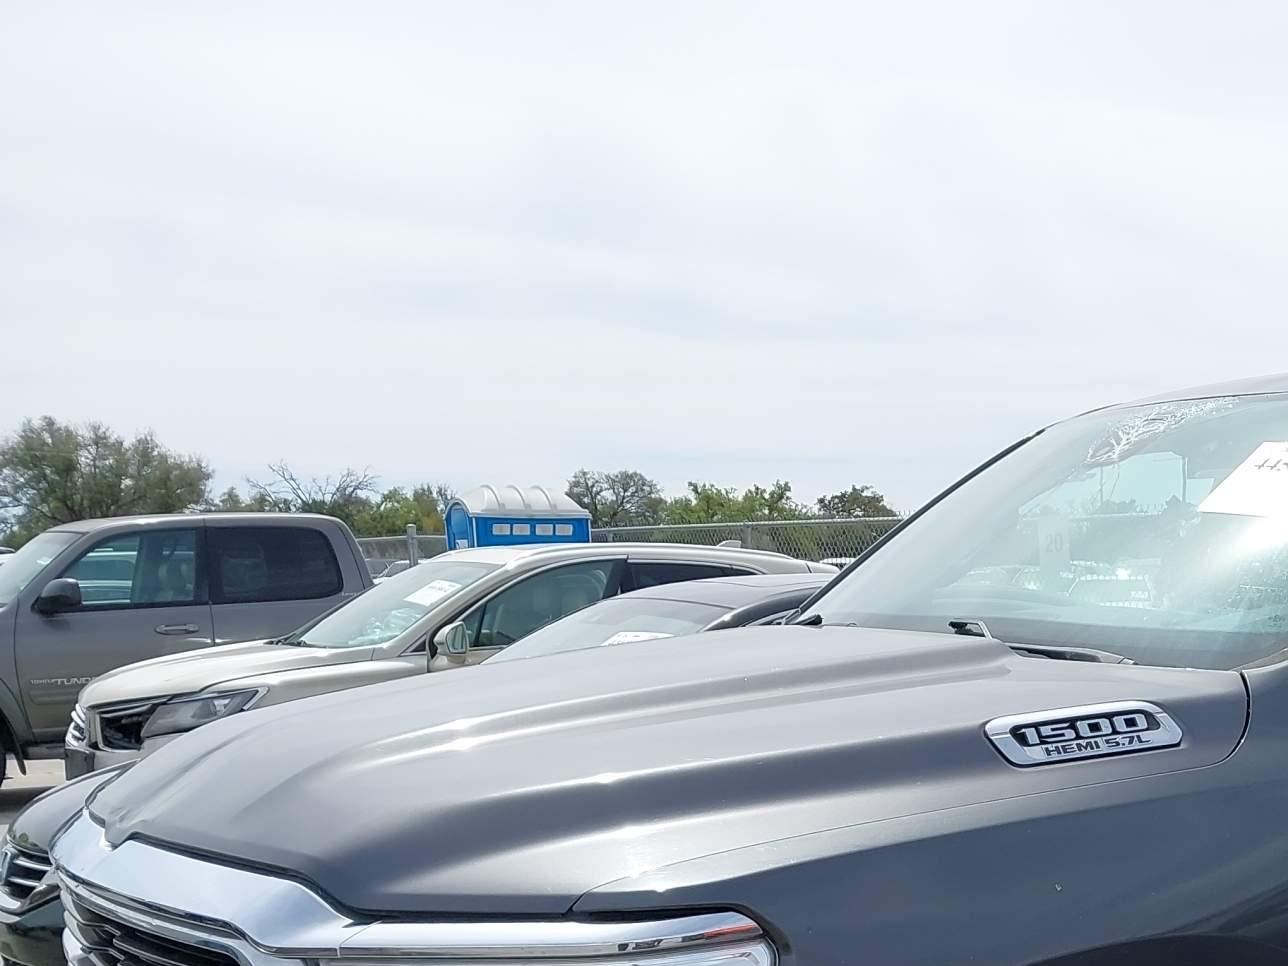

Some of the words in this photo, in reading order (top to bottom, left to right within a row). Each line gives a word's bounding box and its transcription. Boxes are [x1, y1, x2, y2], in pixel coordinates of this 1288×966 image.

[52, 677, 95, 685] TUND
[1016, 713, 1148, 745] 1500
[1045, 738, 1101, 757] HEMI
[1105, 734, 1151, 749] 5.7L
